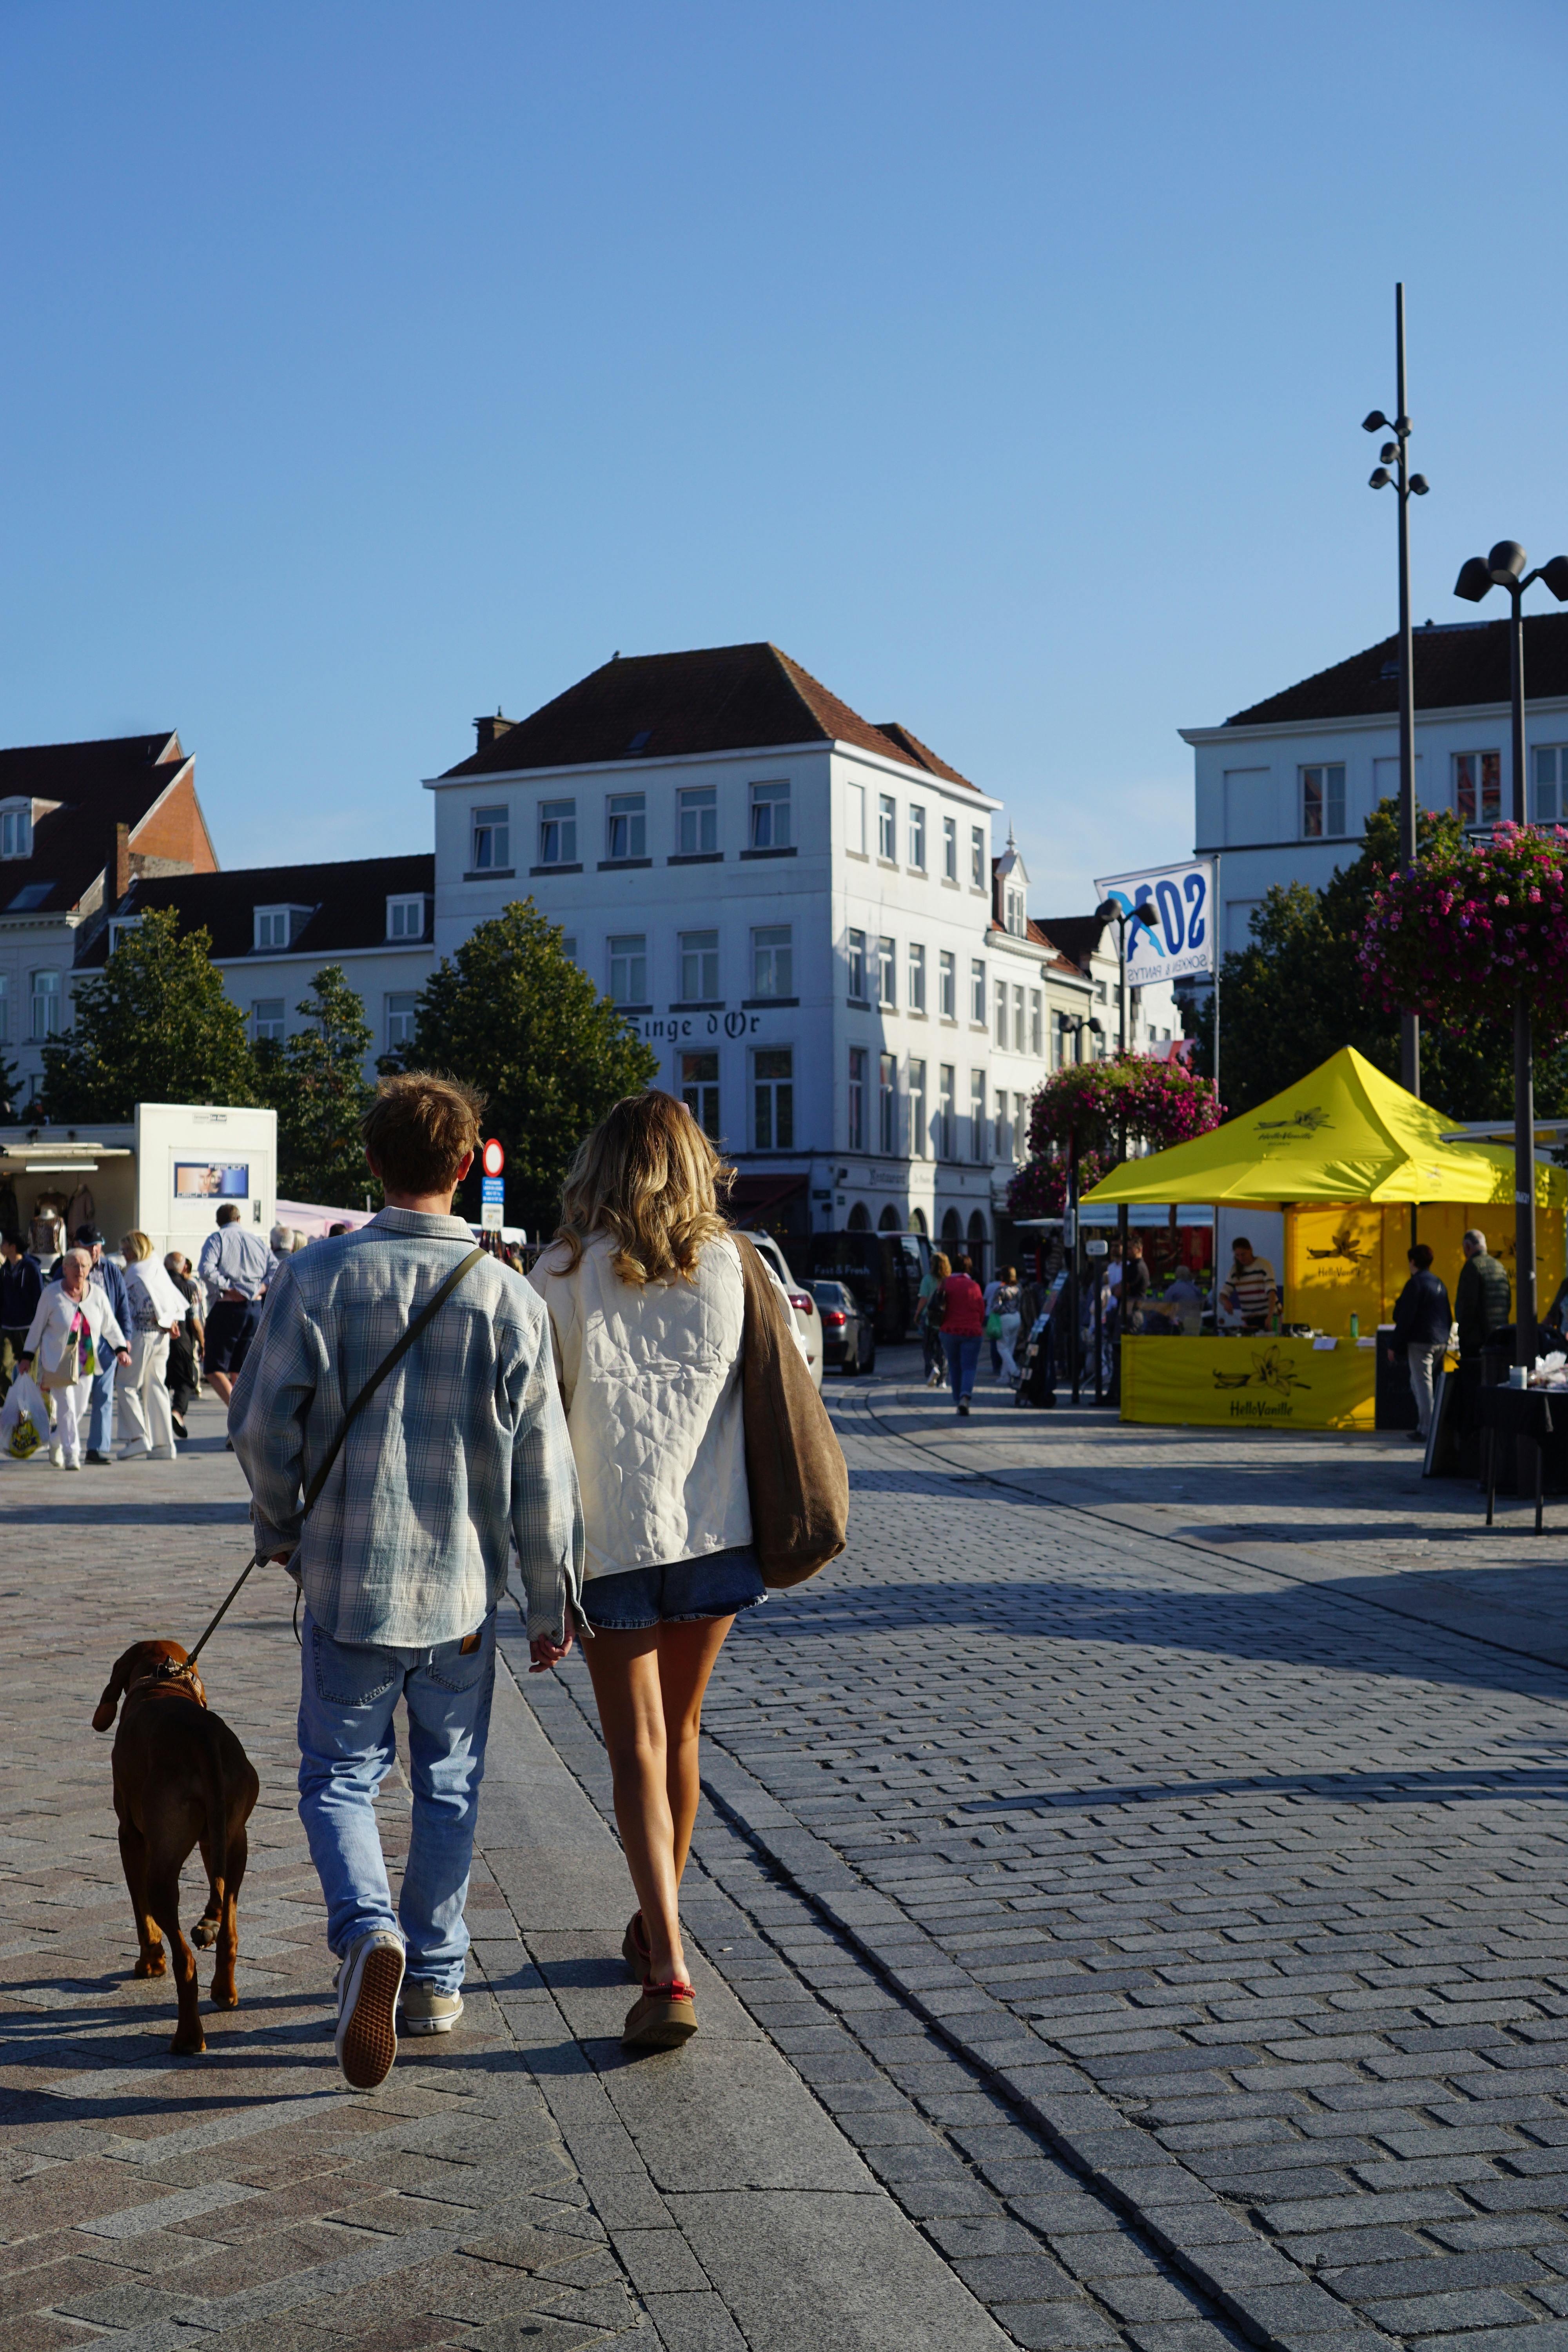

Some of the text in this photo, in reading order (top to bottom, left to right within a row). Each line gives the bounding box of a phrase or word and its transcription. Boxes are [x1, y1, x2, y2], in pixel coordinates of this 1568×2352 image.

[815, 1264, 870, 1274] Fast & Fresh
[1230, 1399, 1293, 1416] HelloVanille
